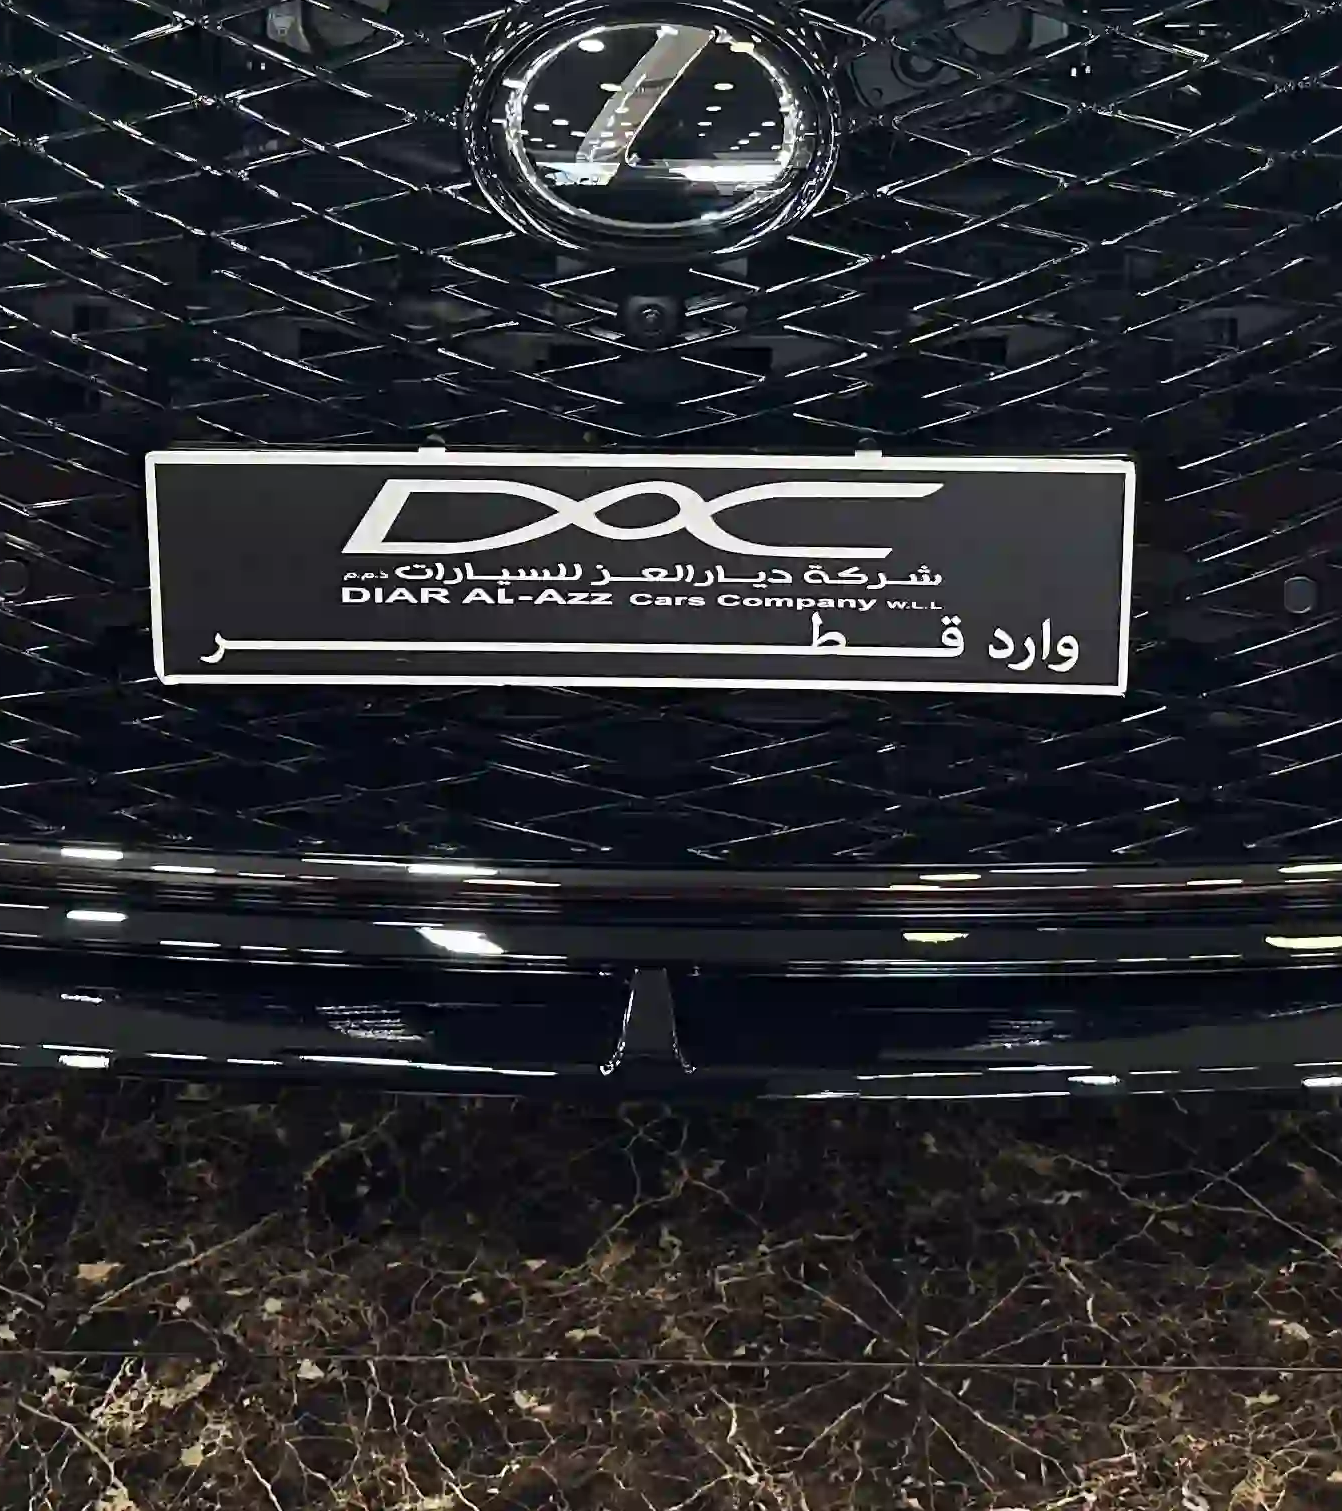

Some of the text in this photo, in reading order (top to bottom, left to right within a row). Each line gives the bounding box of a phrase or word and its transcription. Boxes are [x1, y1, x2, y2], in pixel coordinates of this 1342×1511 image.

[394, 561, 583, 586] للسيارات
[802, 563, 943, 590] شركة
[340, 587, 452, 605] DIAR
[629, 592, 706, 607] Cars
[717, 593, 878, 612] Company
[987, 616, 1081, 673] وارد
